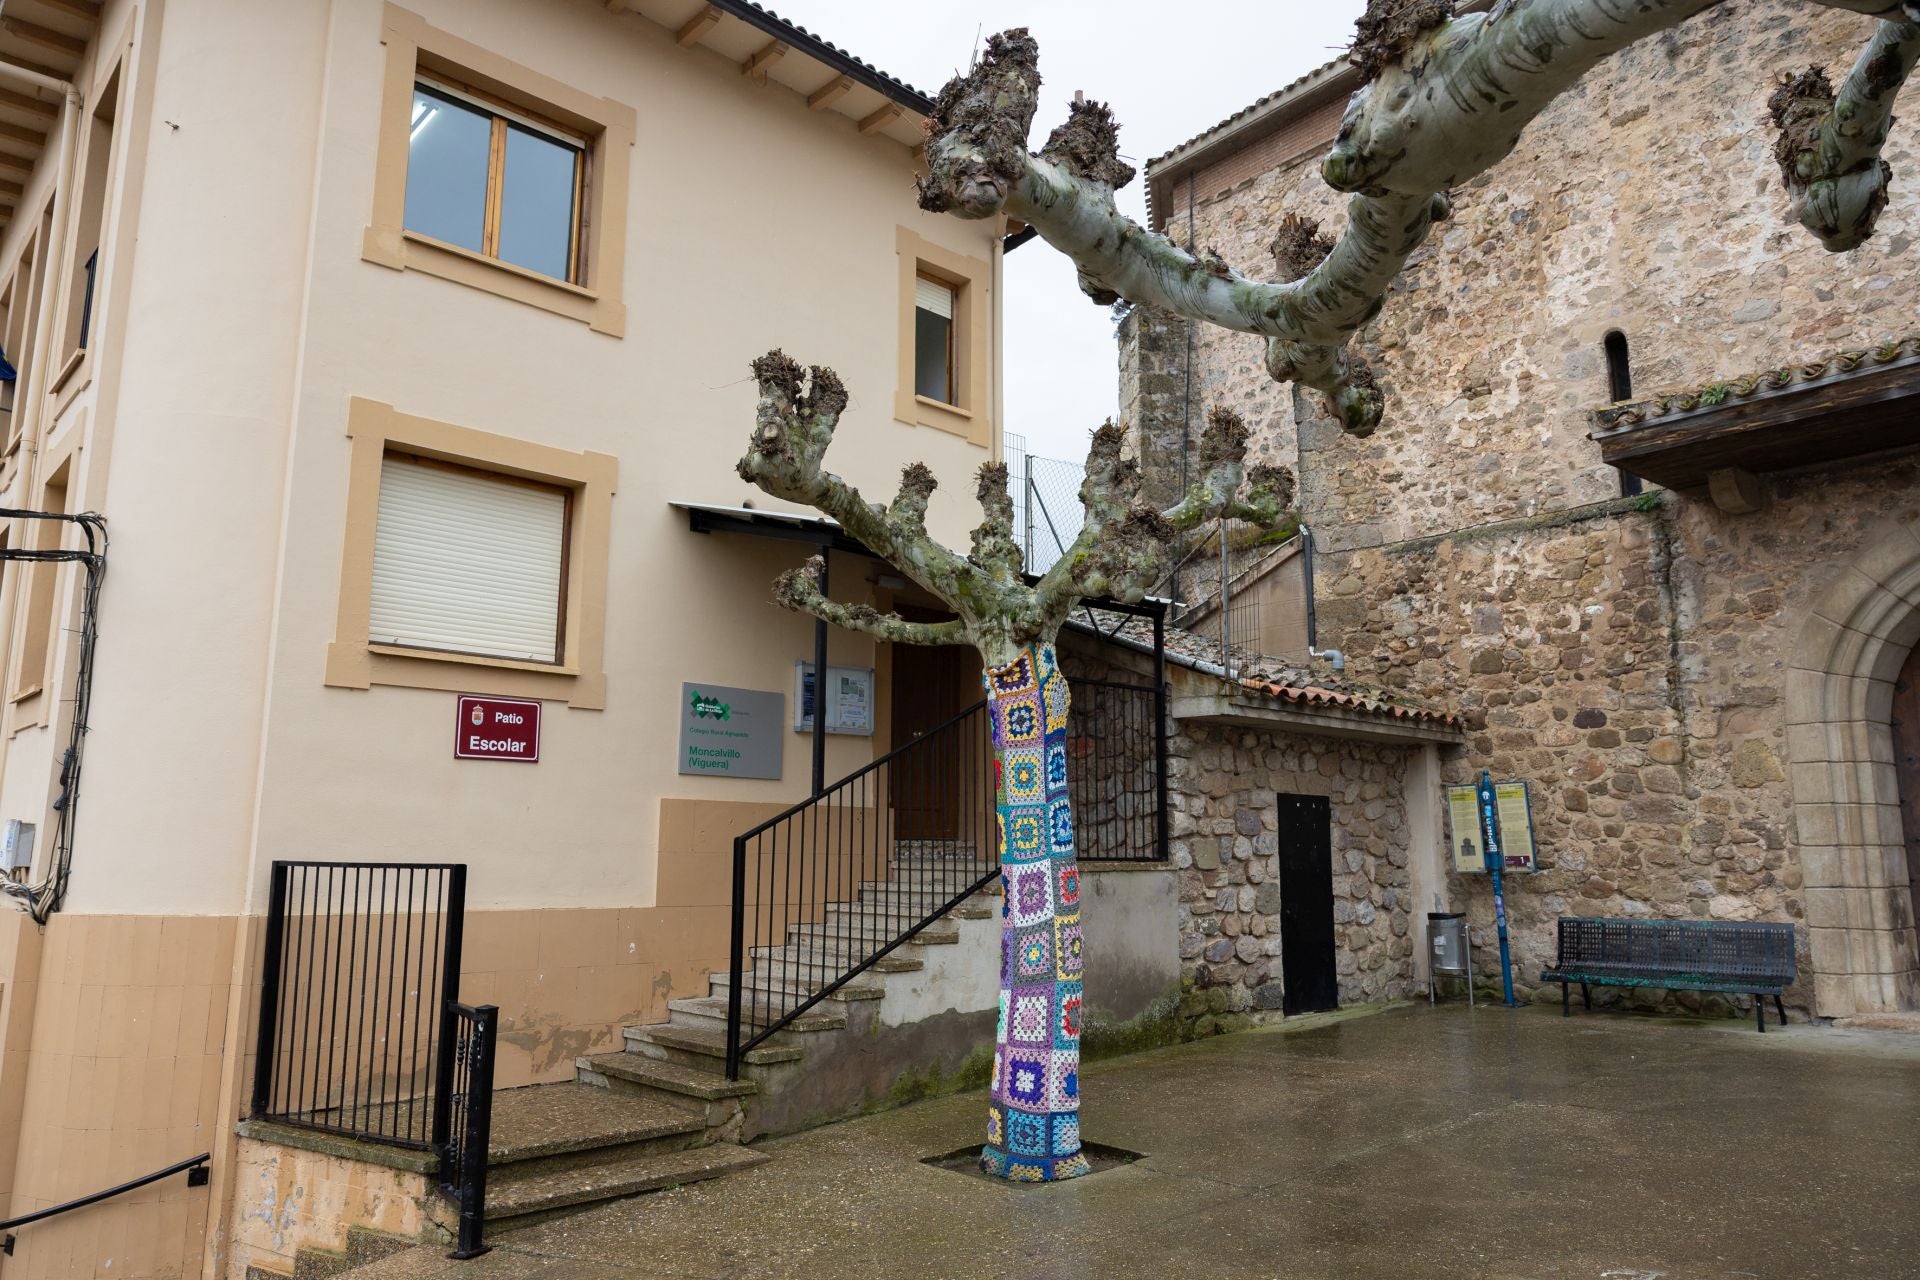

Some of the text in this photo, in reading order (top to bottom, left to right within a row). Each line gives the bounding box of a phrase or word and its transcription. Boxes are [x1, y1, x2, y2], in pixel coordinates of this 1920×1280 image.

[495, 712, 523, 724] Patio
[469, 735, 527, 753] Escolar
[689, 746, 741, 758] Moncalvillo
[688, 758, 729, 770] (Viguera)
[1520, 856, 1524, 864] 1
